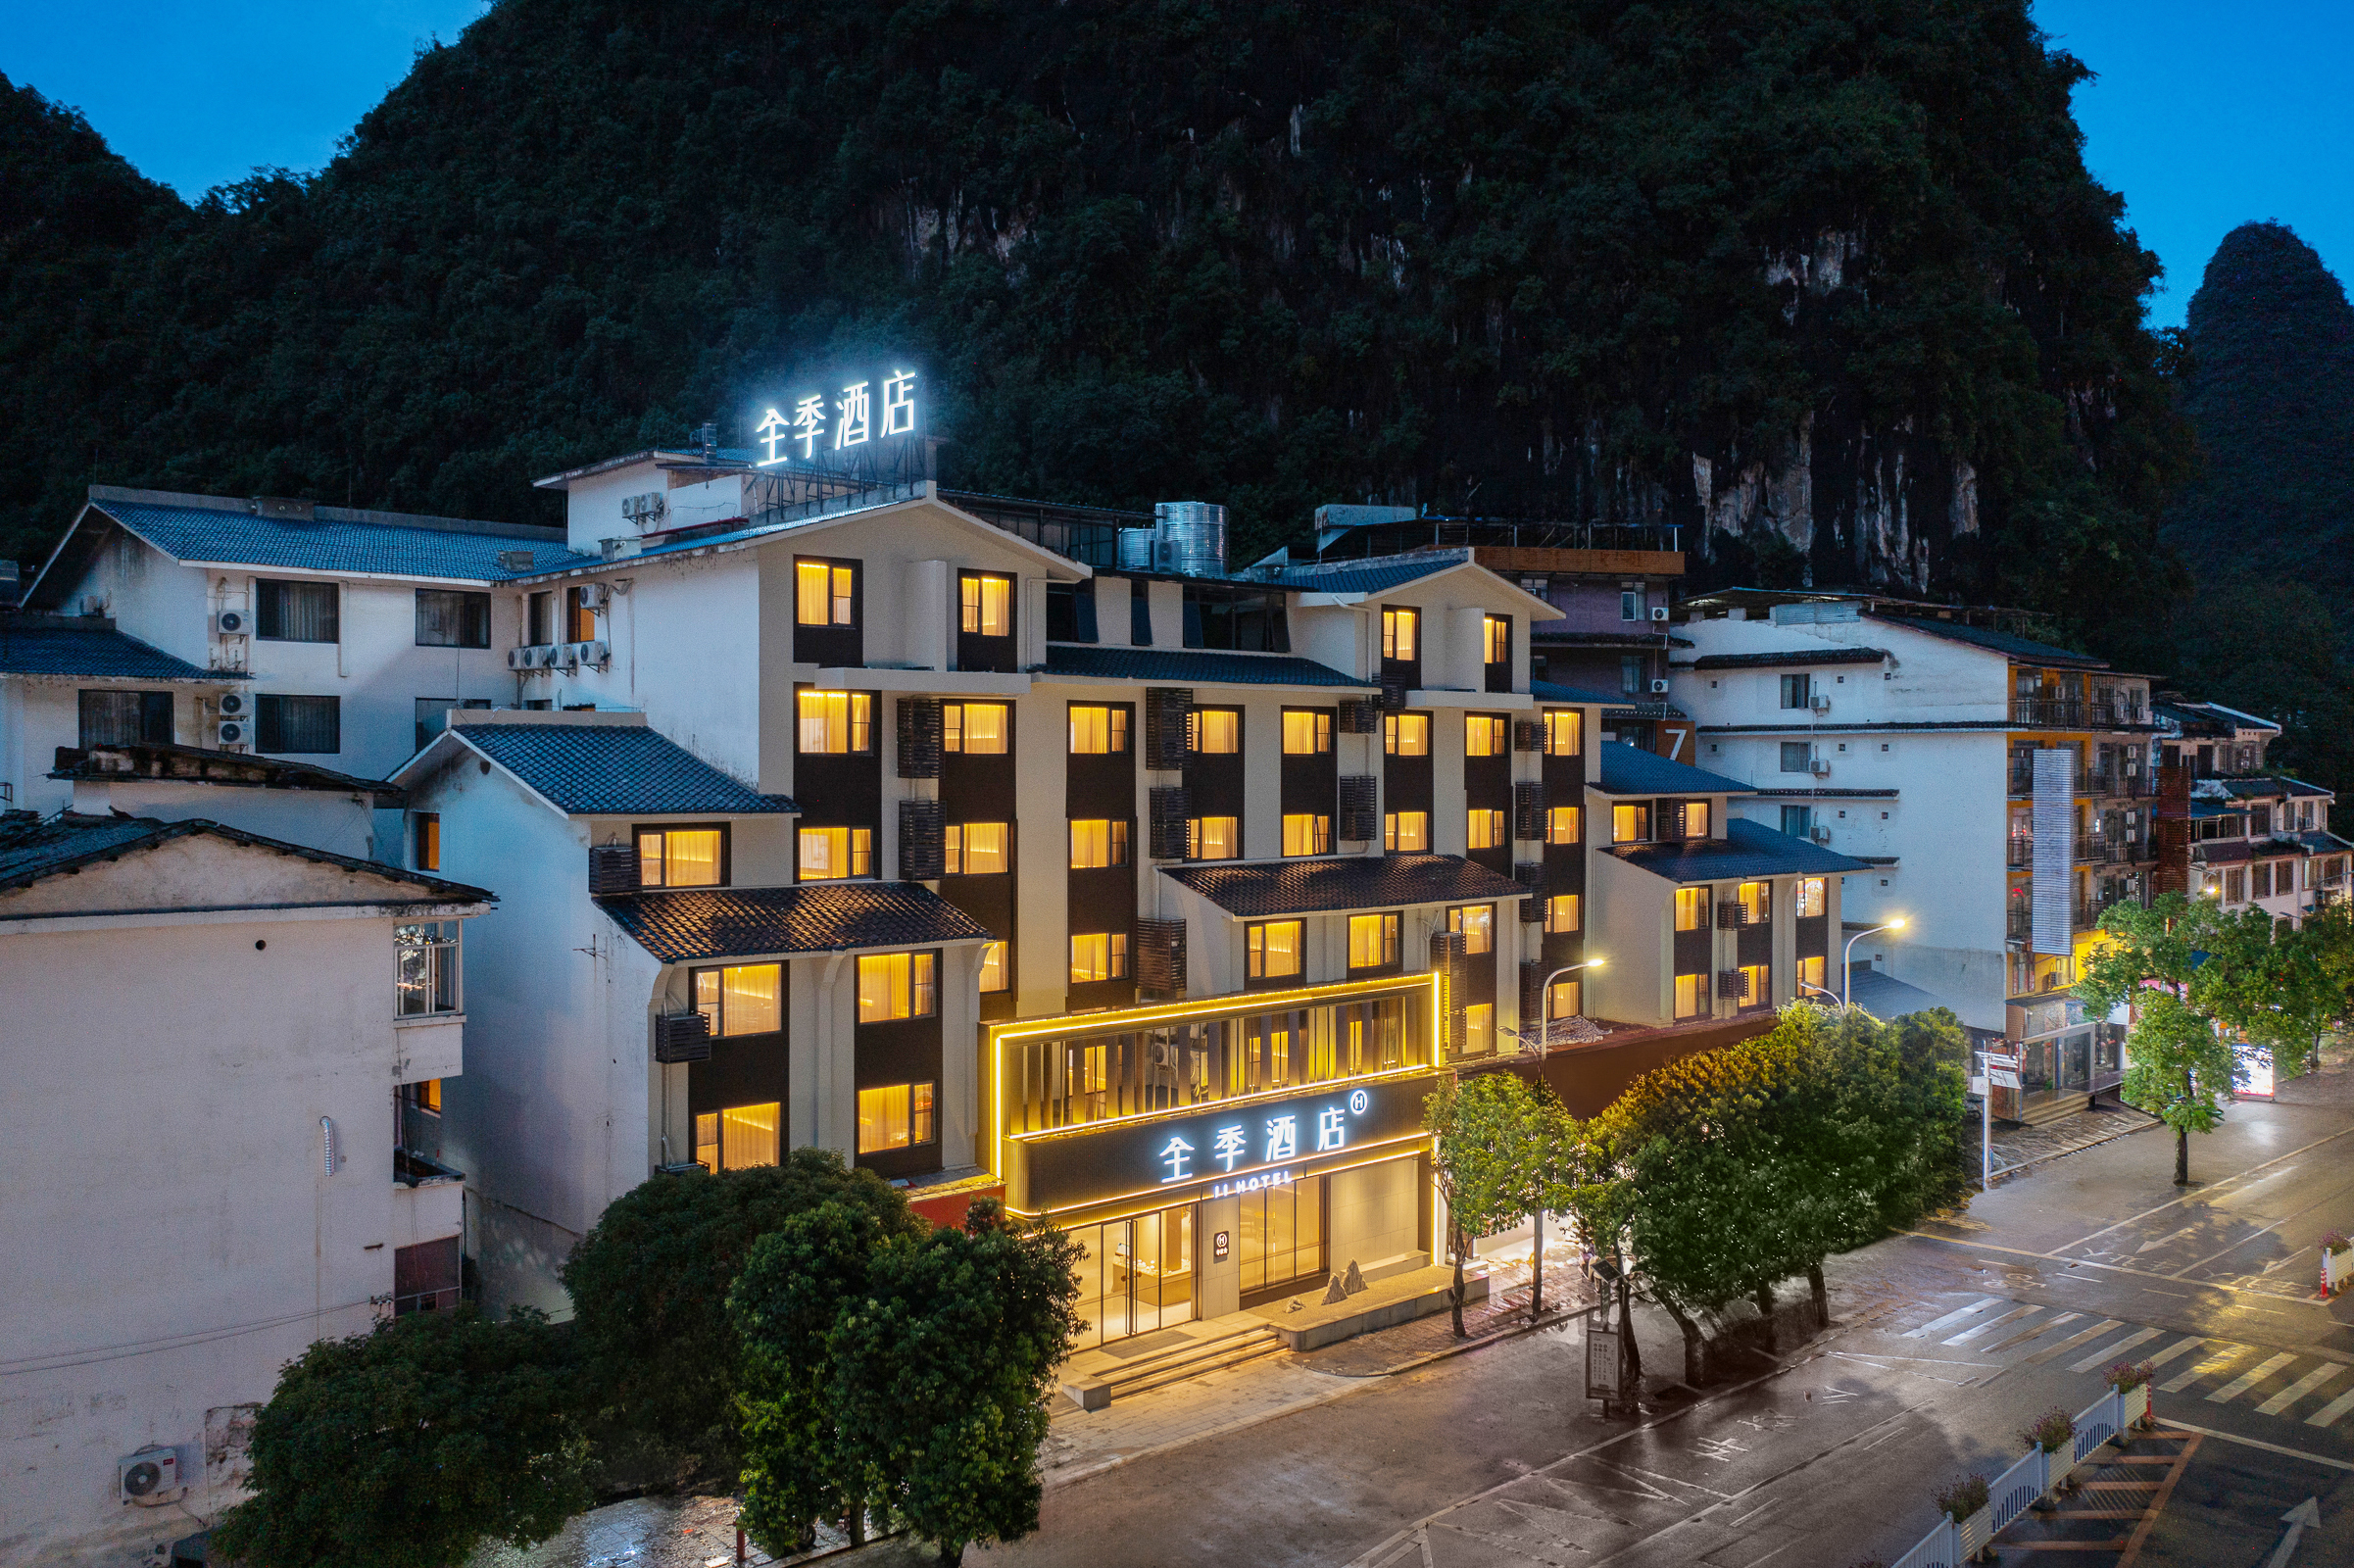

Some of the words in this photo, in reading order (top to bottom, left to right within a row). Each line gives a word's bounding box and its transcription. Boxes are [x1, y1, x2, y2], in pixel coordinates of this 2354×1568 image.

[756, 369, 916, 467] 全季酒店
[1665, 729, 1687, 760] 7
[1159, 1106, 1345, 1184] 全季酒店
[1236, 1170, 1293, 1194] HOTEL
